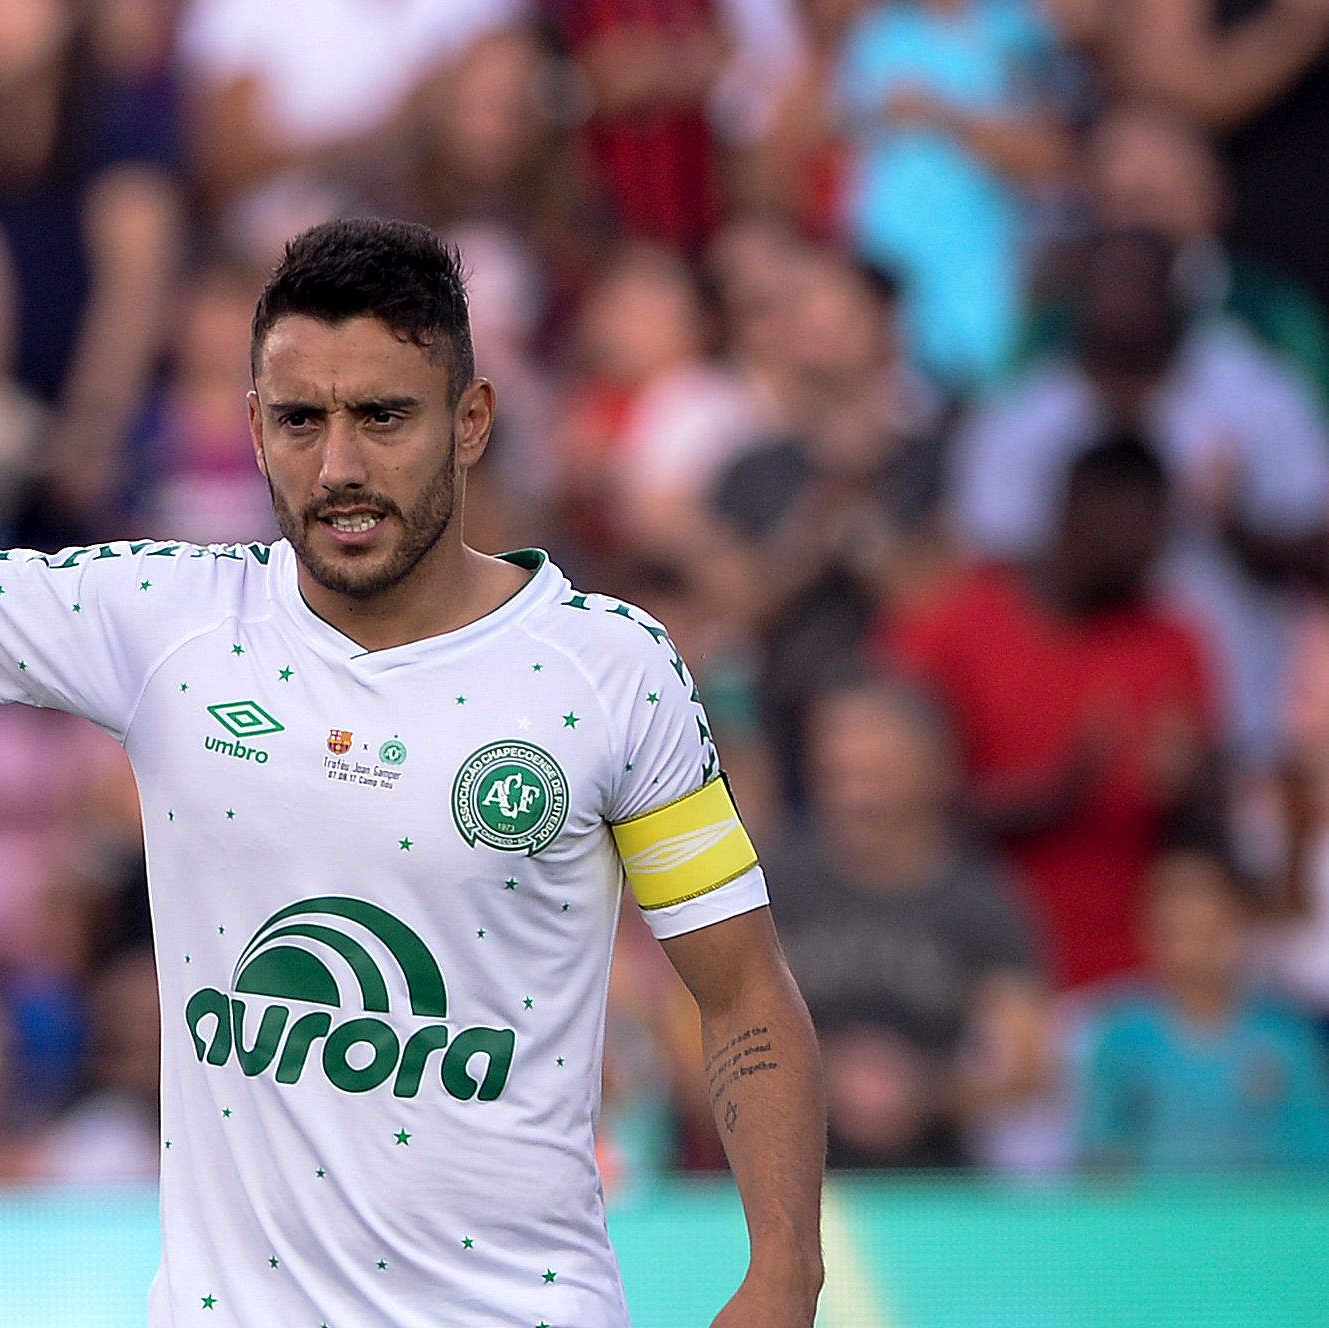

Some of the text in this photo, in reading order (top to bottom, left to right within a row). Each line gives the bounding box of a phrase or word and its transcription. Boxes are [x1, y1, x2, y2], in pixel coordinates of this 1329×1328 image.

[204, 736, 269, 764] umbro
[480, 747, 557, 779] CHAPECOENSE
[353, 762, 370, 774] Joan
[373, 766, 401, 780] Gamper
[358, 776, 378, 787] Camp
[184, 987, 517, 1102] aurora
